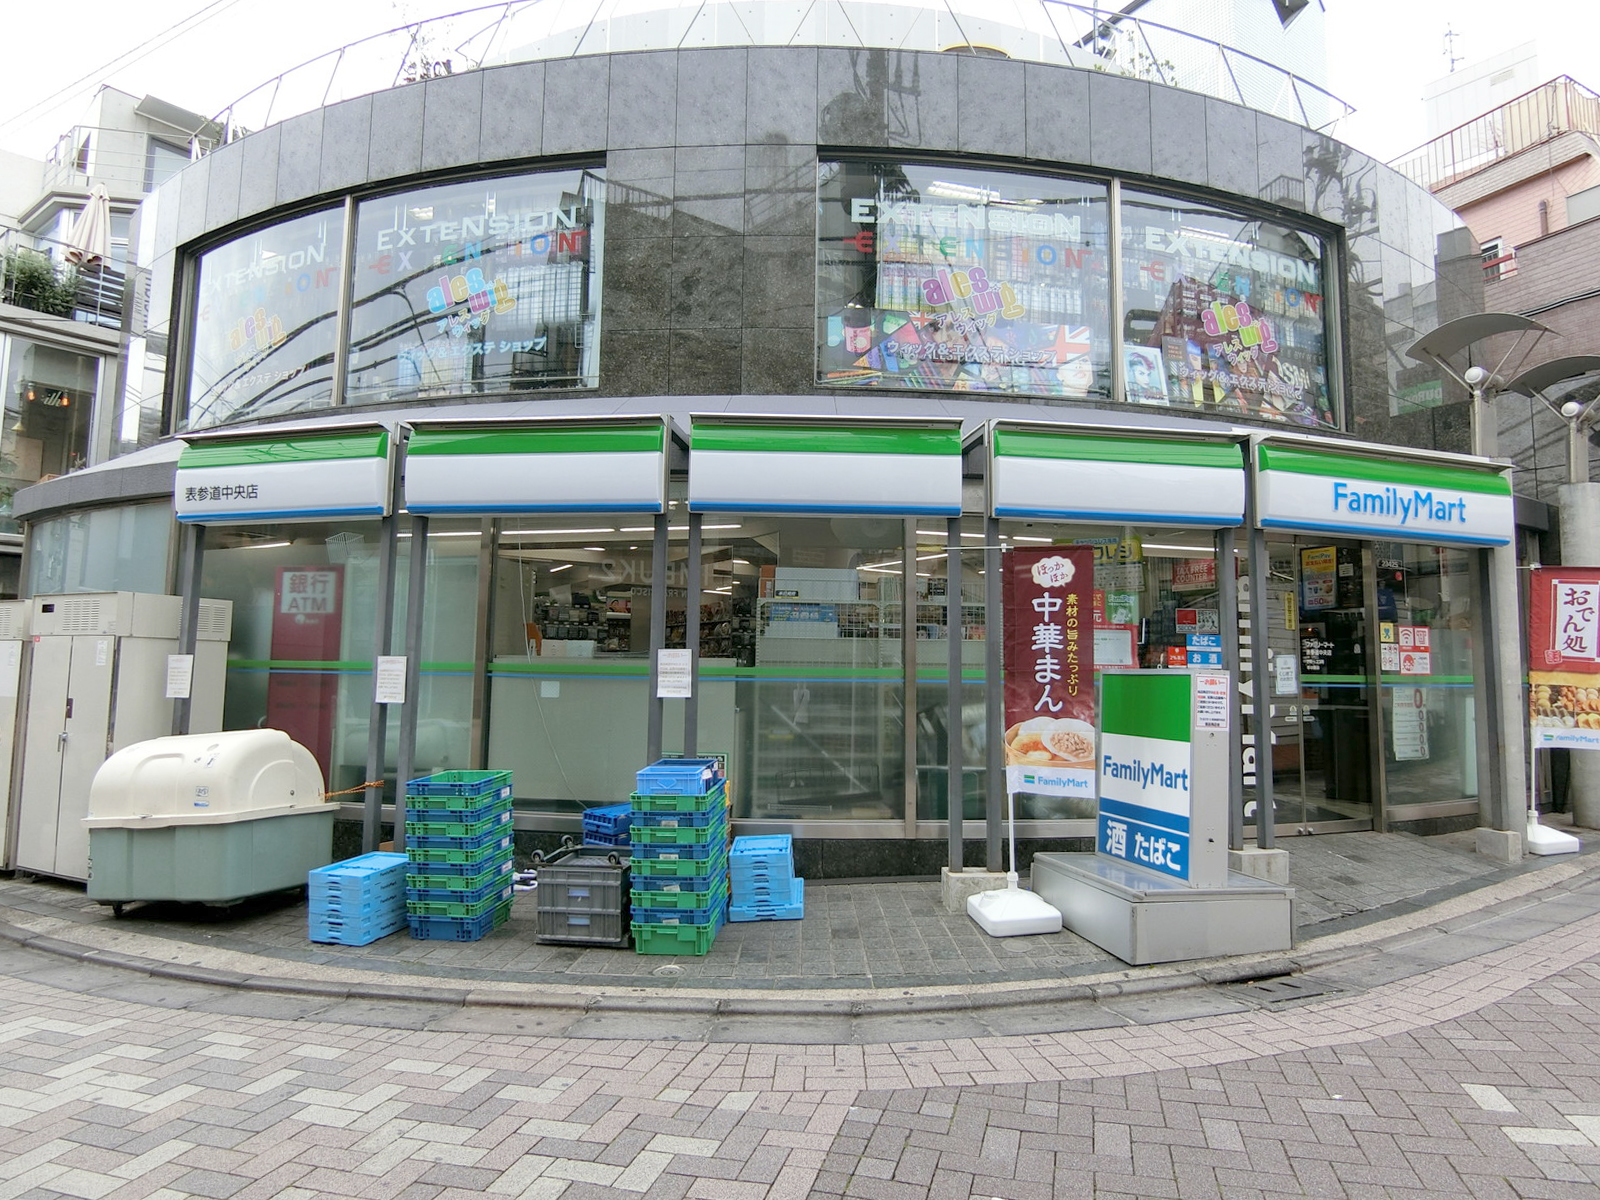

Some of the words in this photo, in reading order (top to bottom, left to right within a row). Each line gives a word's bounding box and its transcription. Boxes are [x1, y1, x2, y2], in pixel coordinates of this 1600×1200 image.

[377, 206, 577, 251] EXTENSION
[851, 198, 1081, 240] EXTENSION
[202, 241, 327, 297] EXTENSION
[369, 230, 588, 275] EXENION
[1145, 225, 1315, 285] EXTENSION
[427, 267, 486, 314] ales
[921, 267, 990, 306] ales
[971, 282, 1026, 320] wig
[1140, 261, 1324, 315] EXENION
[936, 307, 975, 328] アレス
[1201, 301, 1252, 337] ales
[1239, 318, 1278, 354] wig
[1213, 338, 1242, 358] アレス
[184, 484, 259, 502] 表参道中央店
[1333, 482, 1466, 525] FamilyMart
[288, 573, 330, 594] 銀行
[1037, 560, 1064, 577] ほっか
[1050, 571, 1069, 584] ほか
[1175, 572, 1208, 583] COUNTER
[1176, 567, 1190, 575] TAX
[1190, 563, 1208, 574] FREE
[287, 596, 327, 612] ATM
[1562, 587, 1596, 653] おでん処
[1031, 591, 1065, 713] 中華まん
[1065, 593, 1079, 698] 素材の旨みたっぷり
[1191, 635, 1217, 647] たばこ
[1192, 653, 1218, 663] お酒
[1037, 775, 1088, 789] FamilyMart
[1103, 754, 1189, 791] FamilyMart
[1105, 819, 1127, 858] 酒
[1134, 832, 1181, 872] たばこ
